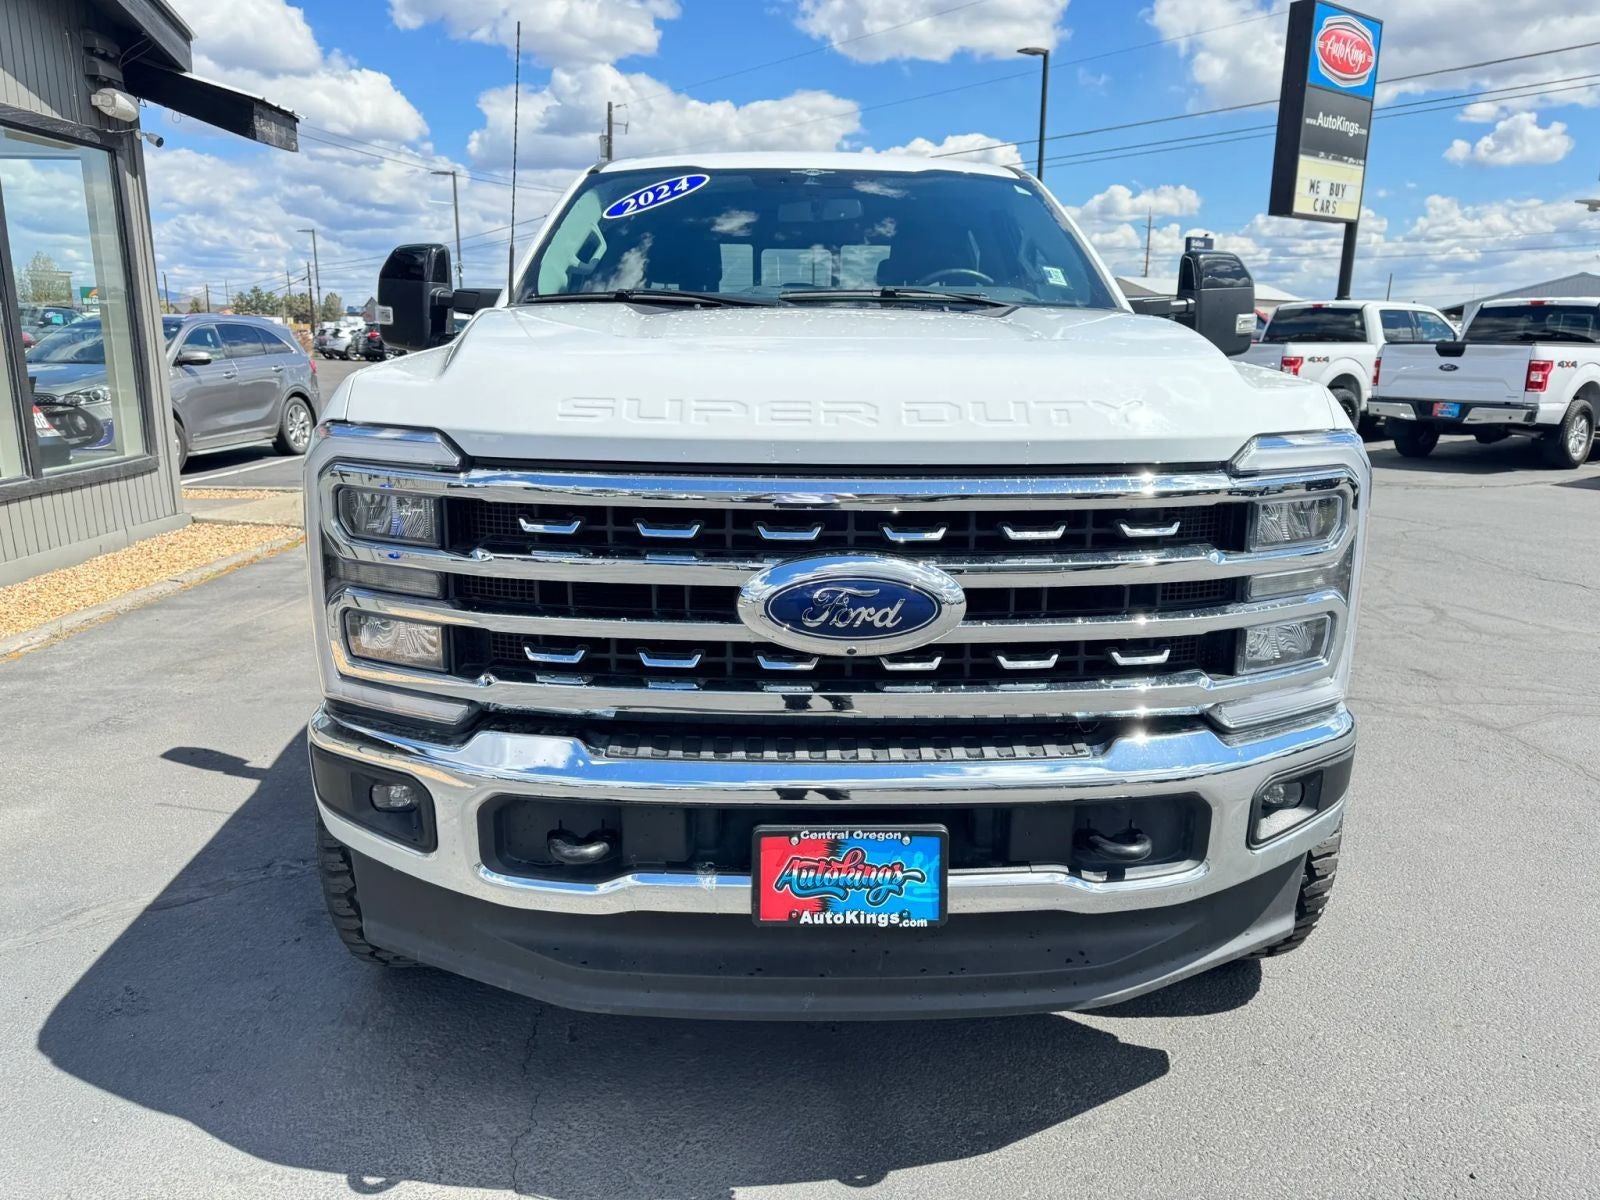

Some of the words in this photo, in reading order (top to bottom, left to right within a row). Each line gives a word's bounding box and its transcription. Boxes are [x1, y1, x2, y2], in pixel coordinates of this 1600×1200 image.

[622, 177, 690, 214] 2024
[1309, 179, 1320, 194] WE
[1329, 182, 1347, 197] BUY
[1313, 198, 1337, 214] CARS
[556, 397, 879, 426] SUPER
[902, 399, 1144, 428] DUTY
[801, 587, 906, 628] Ford
[800, 830, 849, 840] Central
[853, 830, 902, 842] Oregon
[799, 910, 928, 927] AutoKings.com
